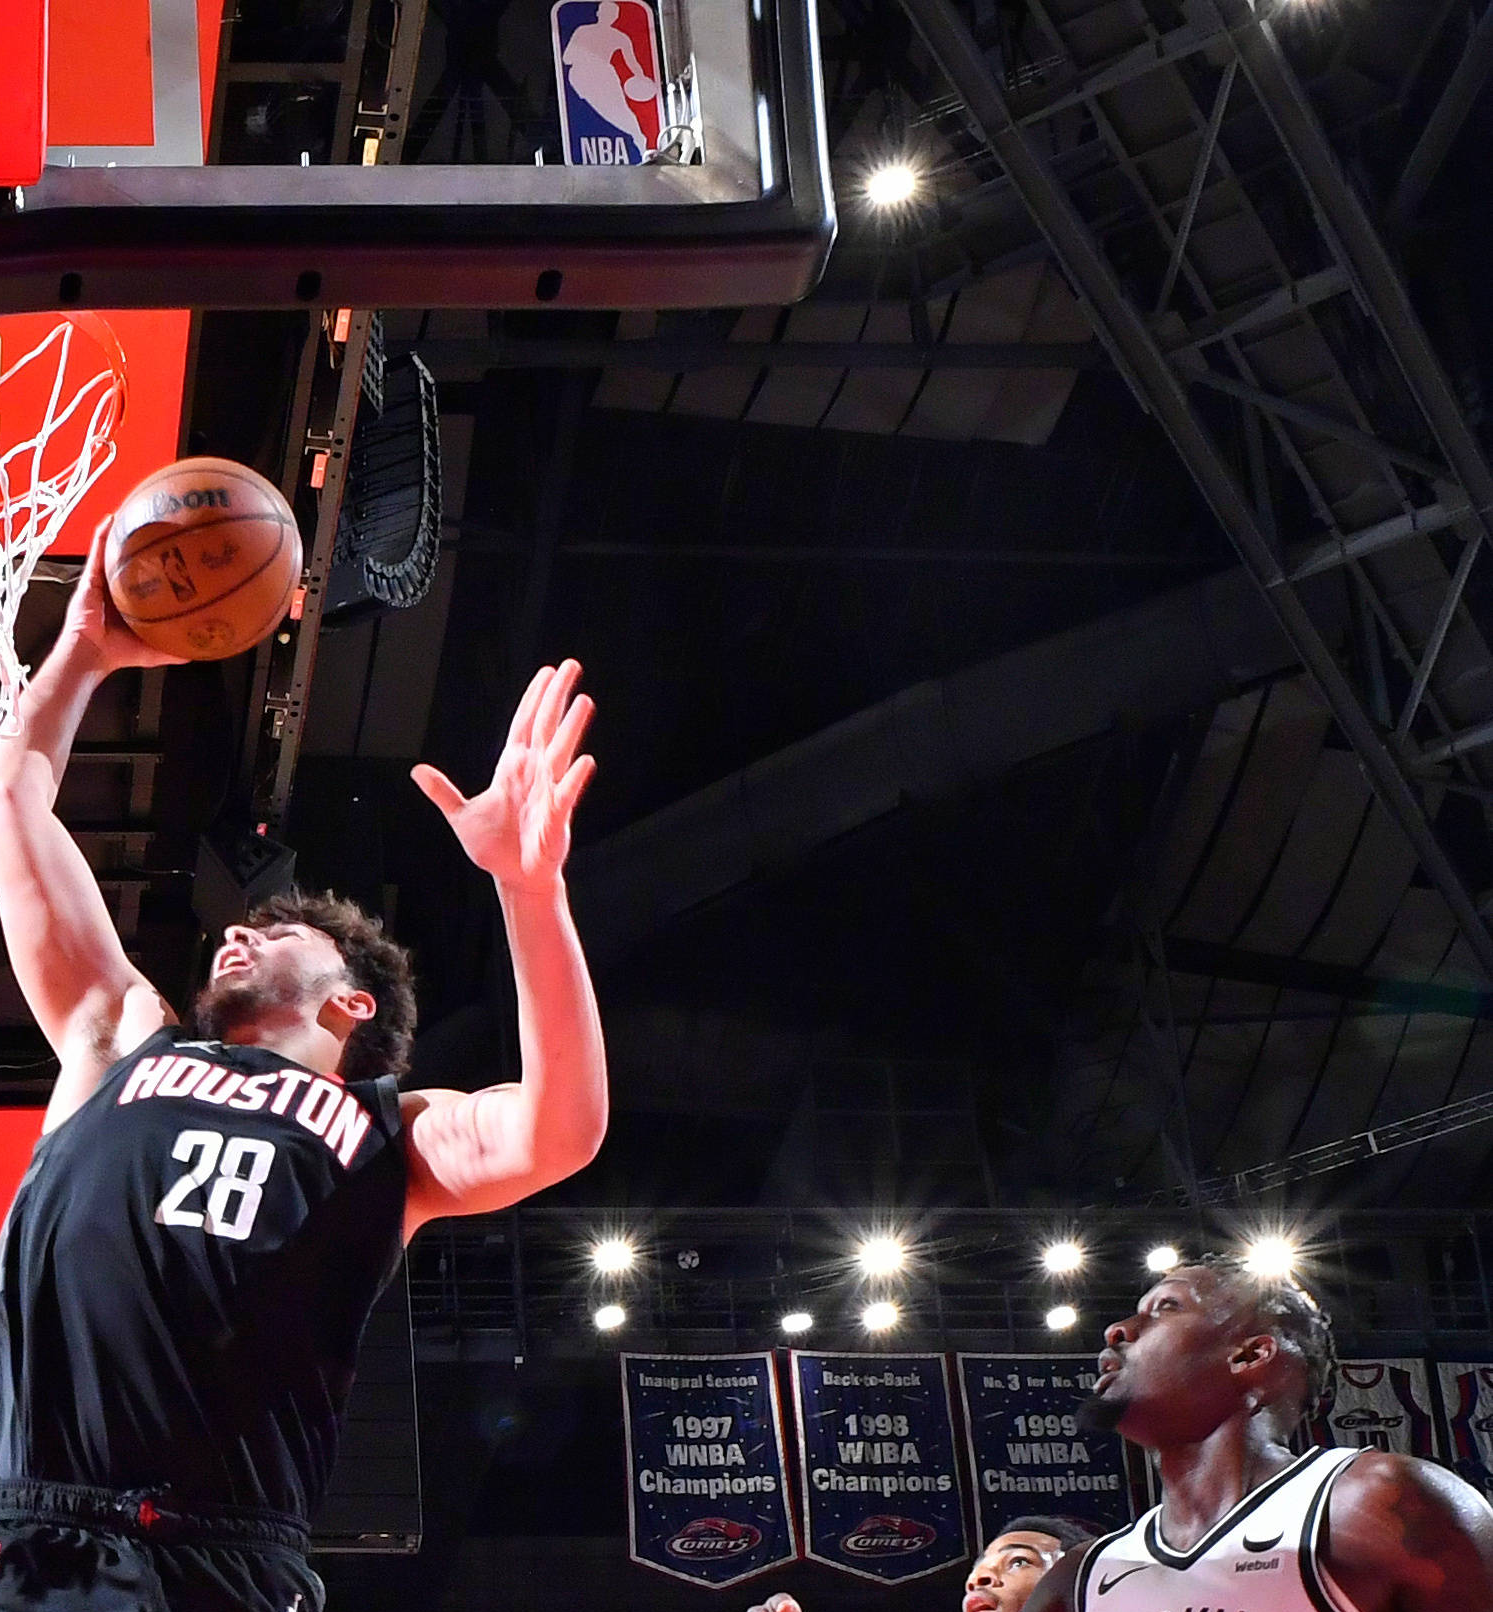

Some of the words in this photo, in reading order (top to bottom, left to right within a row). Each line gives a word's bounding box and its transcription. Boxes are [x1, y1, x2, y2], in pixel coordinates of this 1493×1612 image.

[580, 137, 629, 165] NBA
[119, 1054, 371, 1169] HOUSTON
[155, 1130, 276, 1242] 28
[639, 1372, 703, 1391] Inaugural
[705, 1373, 759, 1388] Season
[822, 1371, 922, 1387] Back-to-Back
[983, 1376, 1005, 1389] No.
[1007, 1374, 1020, 1391] 3
[1052, 1376, 1074, 1388] No.
[672, 1415, 733, 1439] 1997
[844, 1414, 910, 1437] 1998
[1013, 1415, 1078, 1437] 1999
[665, 1443, 746, 1466] WNBA
[837, 1442, 922, 1465] WNBA
[1006, 1442, 1090, 1465] WNBA
[639, 1468, 777, 1500] Champions
[812, 1468, 952, 1498] Champions
[983, 1469, 1120, 1497] Champions
[1234, 1557, 1281, 1574] Webull
